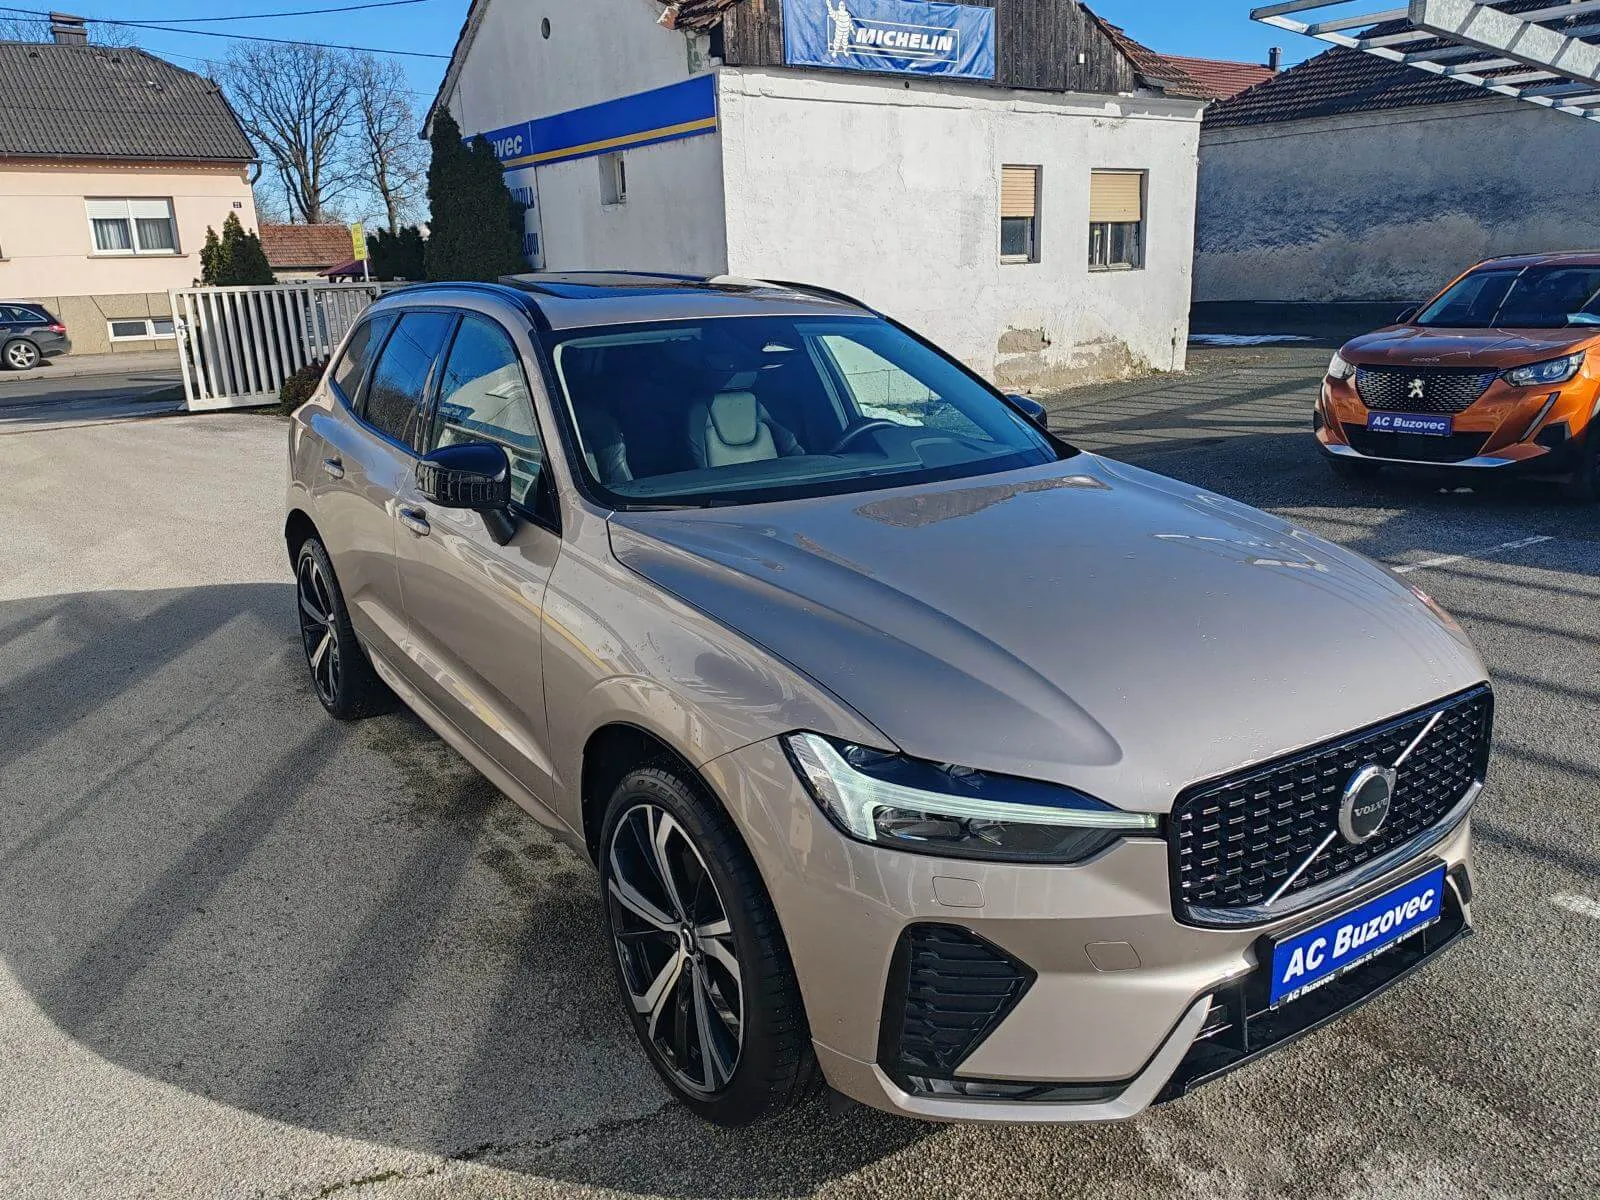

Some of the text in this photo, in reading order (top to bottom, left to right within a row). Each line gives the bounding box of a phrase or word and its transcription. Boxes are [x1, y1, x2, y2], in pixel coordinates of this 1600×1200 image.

[855, 28, 953, 51] MICHELIN
[1373, 416, 1445, 430] AC Buzovec
[1354, 797, 1388, 816] VOLVO
[1282, 937, 1327, 984] AC
[1332, 888, 1435, 959] Buzovec
